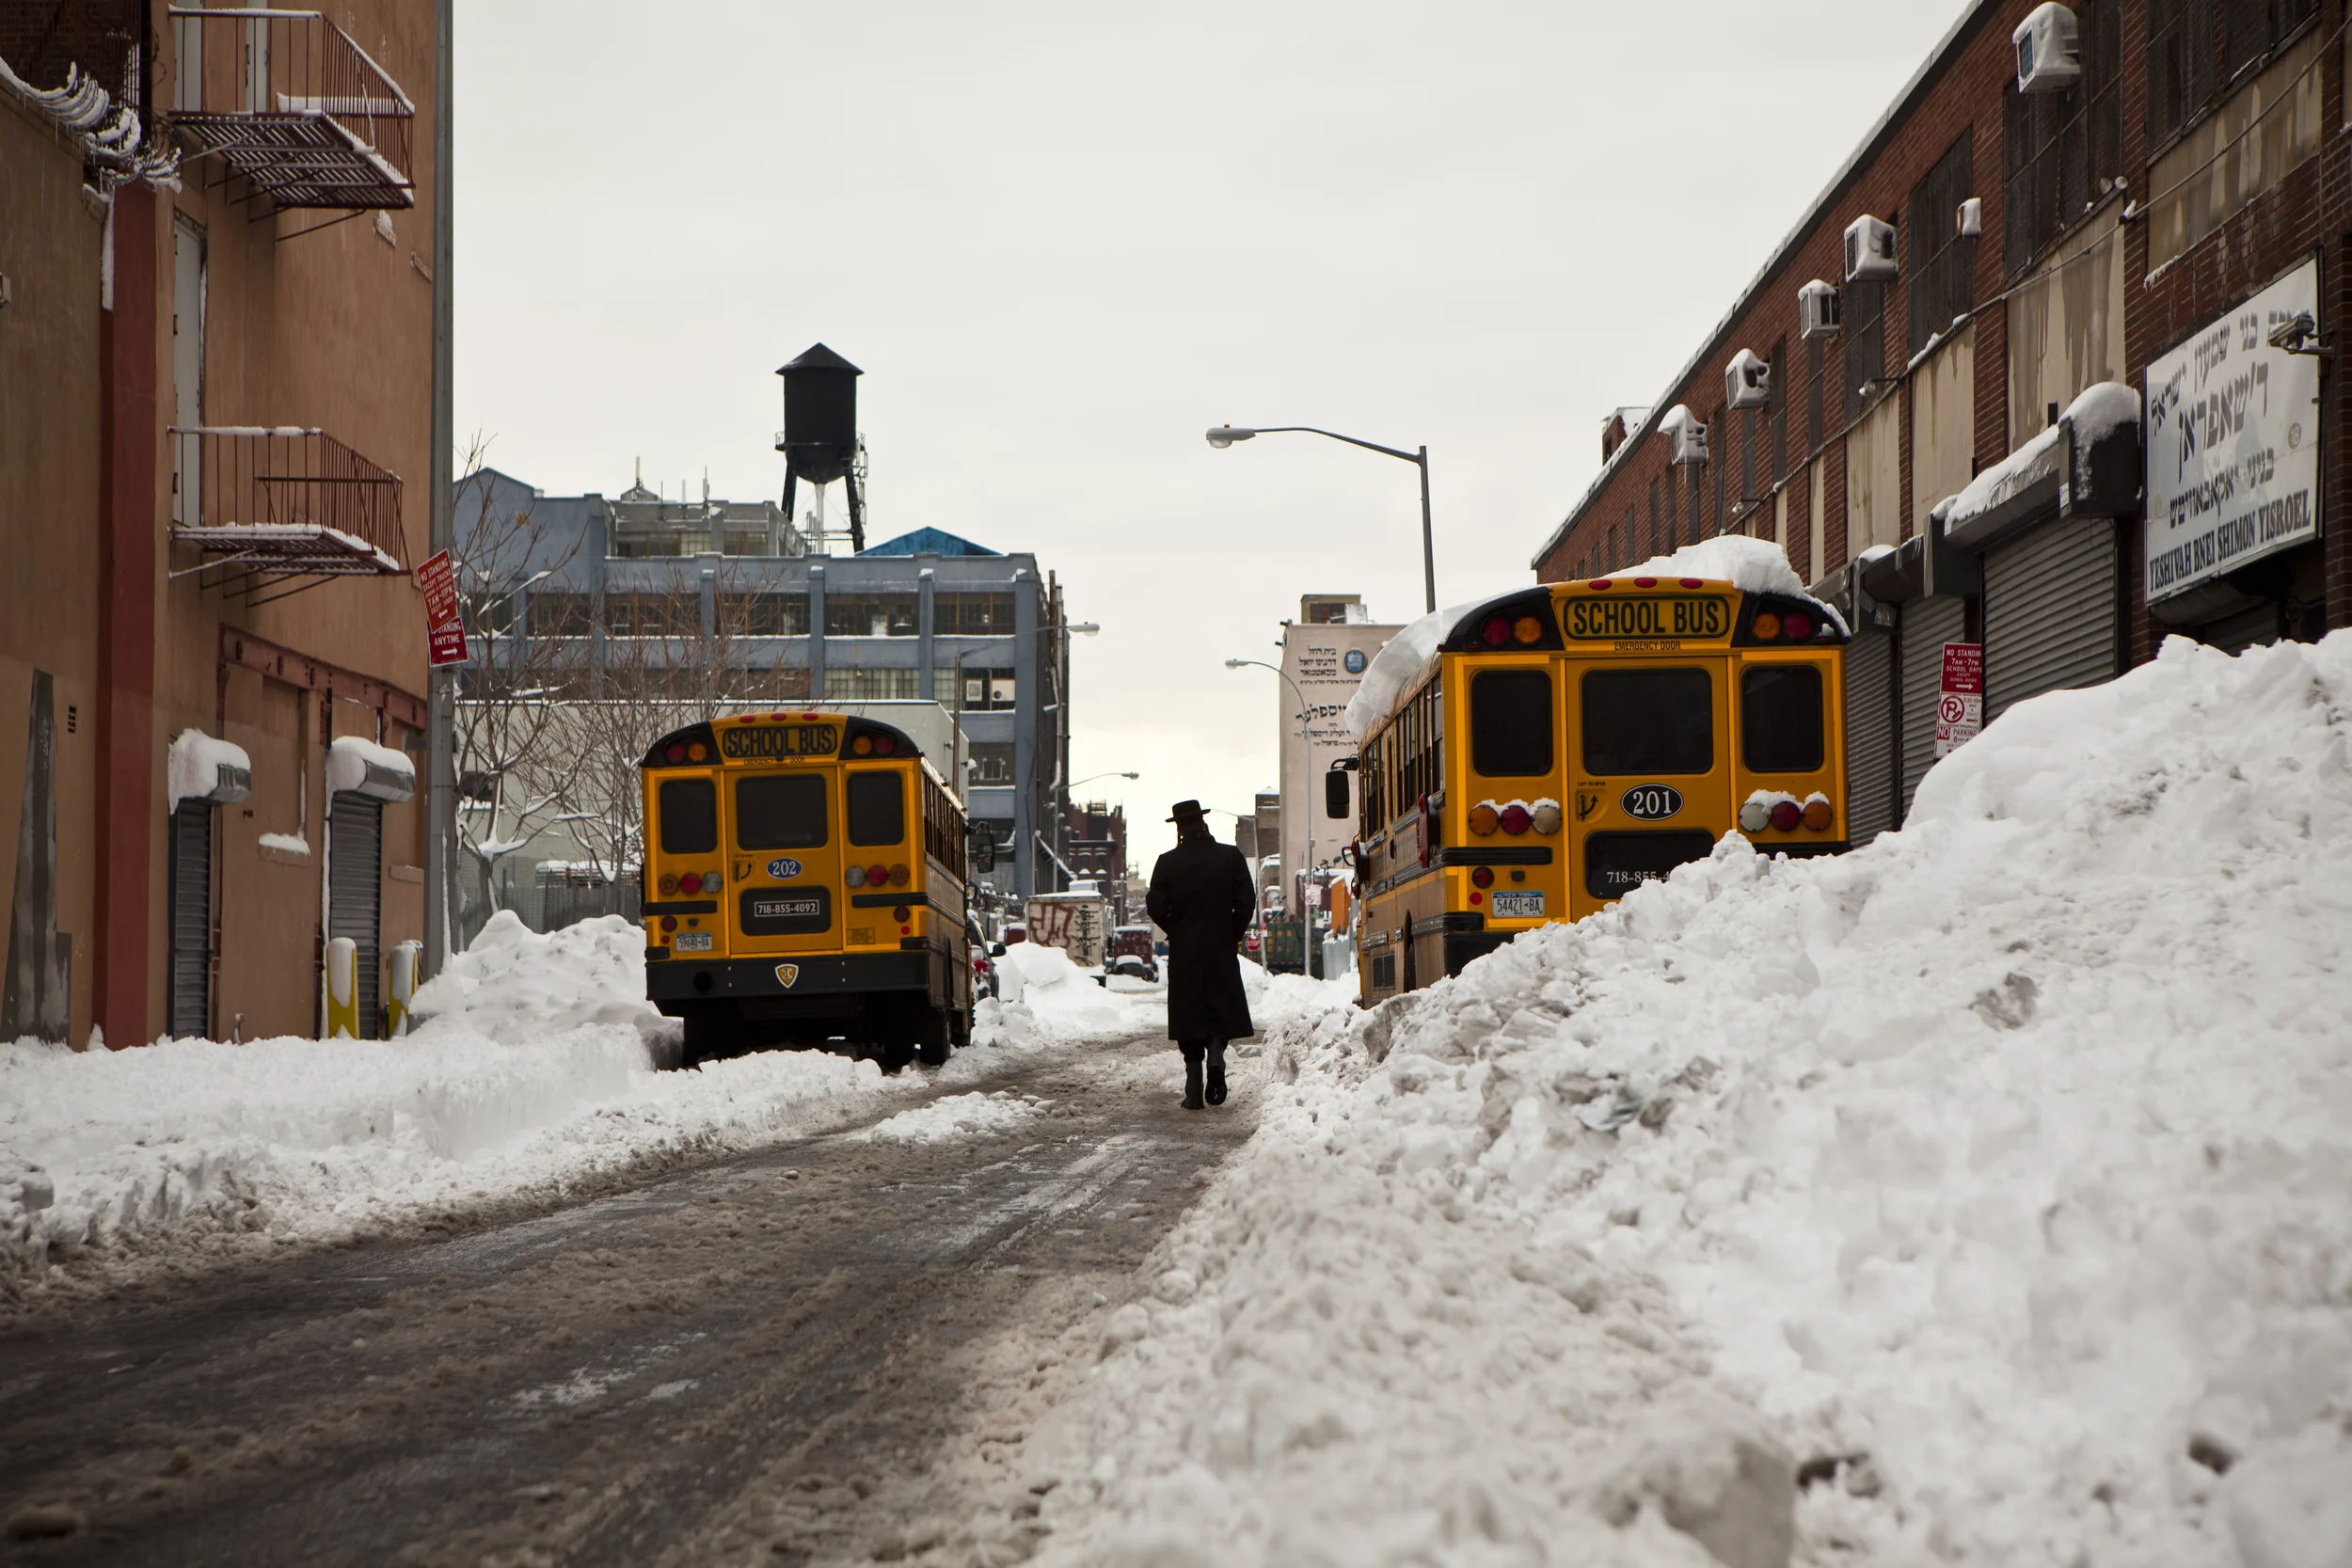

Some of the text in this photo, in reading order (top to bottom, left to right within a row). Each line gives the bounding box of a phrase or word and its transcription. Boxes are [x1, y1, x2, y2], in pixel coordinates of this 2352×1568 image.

[2240, 310, 2258, 352] בני
[2194, 323, 2231, 395] שמעון
[2150, 488, 2312, 592] YESHIVAH BNEI SHIMON YISROEL
[428, 558, 449, 578] STANDING
[422, 578, 437, 593] EXCEPT
[1574, 600, 1719, 635] SCHOOL BUS
[434, 634, 460, 646] ANYTIME
[1614, 641, 1681, 651] EMERGENCY DOOR
[1957, 649, 1981, 657] STANDIN
[1938, 726, 1949, 738] NO
[727, 727, 833, 755] SCHOOL BUS
[743, 756, 775, 766] EMERGENCY
[1632, 790, 1673, 816] 201
[772, 861, 797, 876] 202
[757, 903, 817, 914] 718-855-4092
